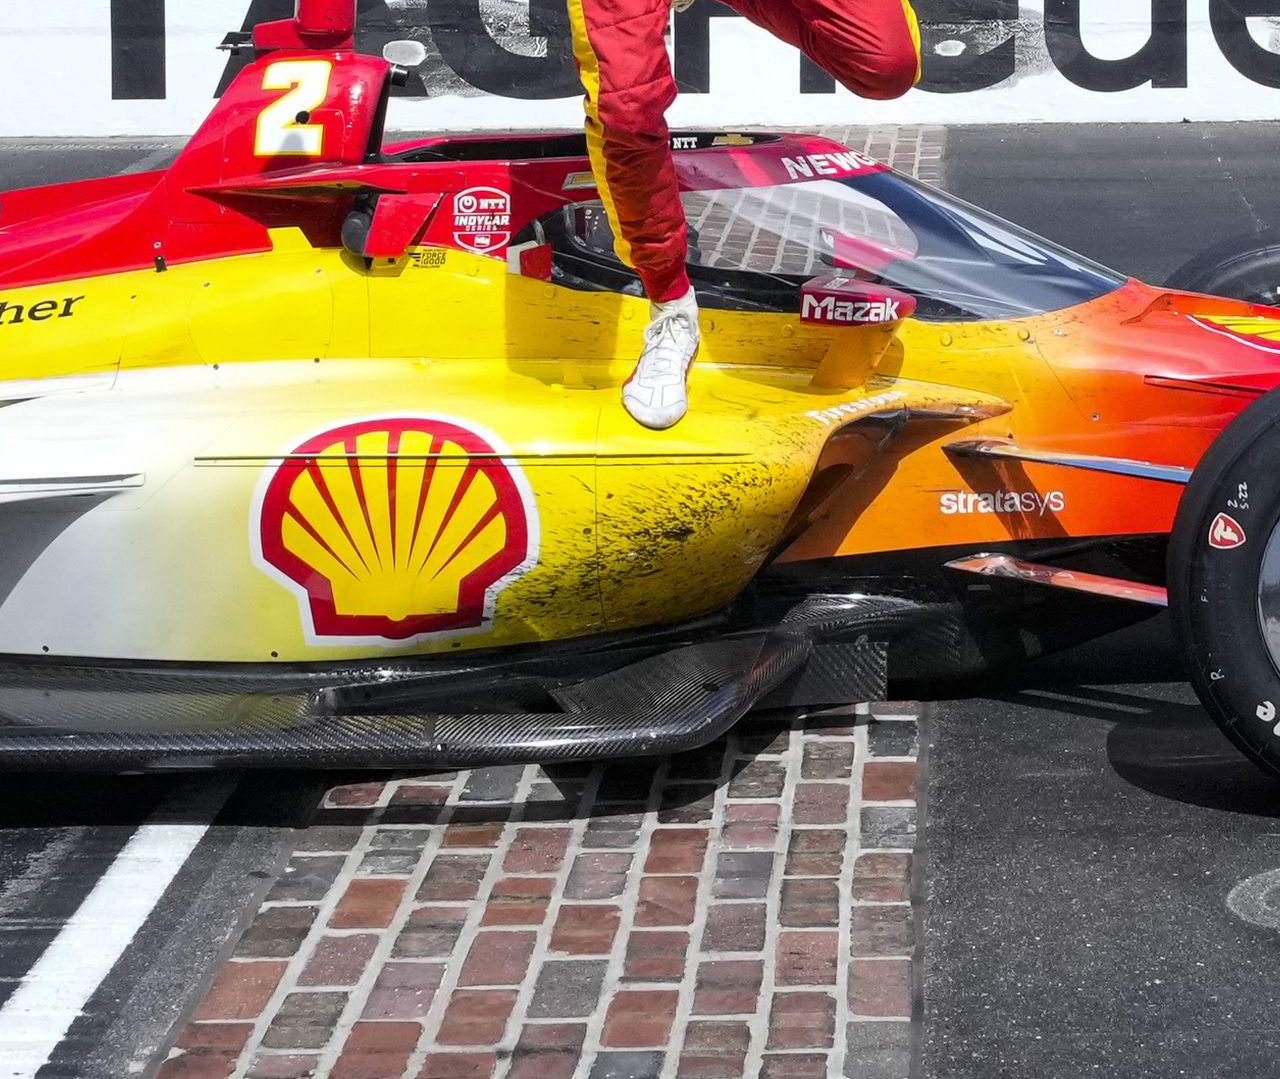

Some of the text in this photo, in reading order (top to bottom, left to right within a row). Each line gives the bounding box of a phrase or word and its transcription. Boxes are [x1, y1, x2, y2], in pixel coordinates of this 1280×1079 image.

[253, 58, 333, 157] 2
[672, 137, 698, 149] NTT
[479, 198, 506, 210] NTT
[454, 215, 510, 226] INDYCAR
[802, 294, 901, 322] Mazak
[939, 489, 1066, 517] stratasys
